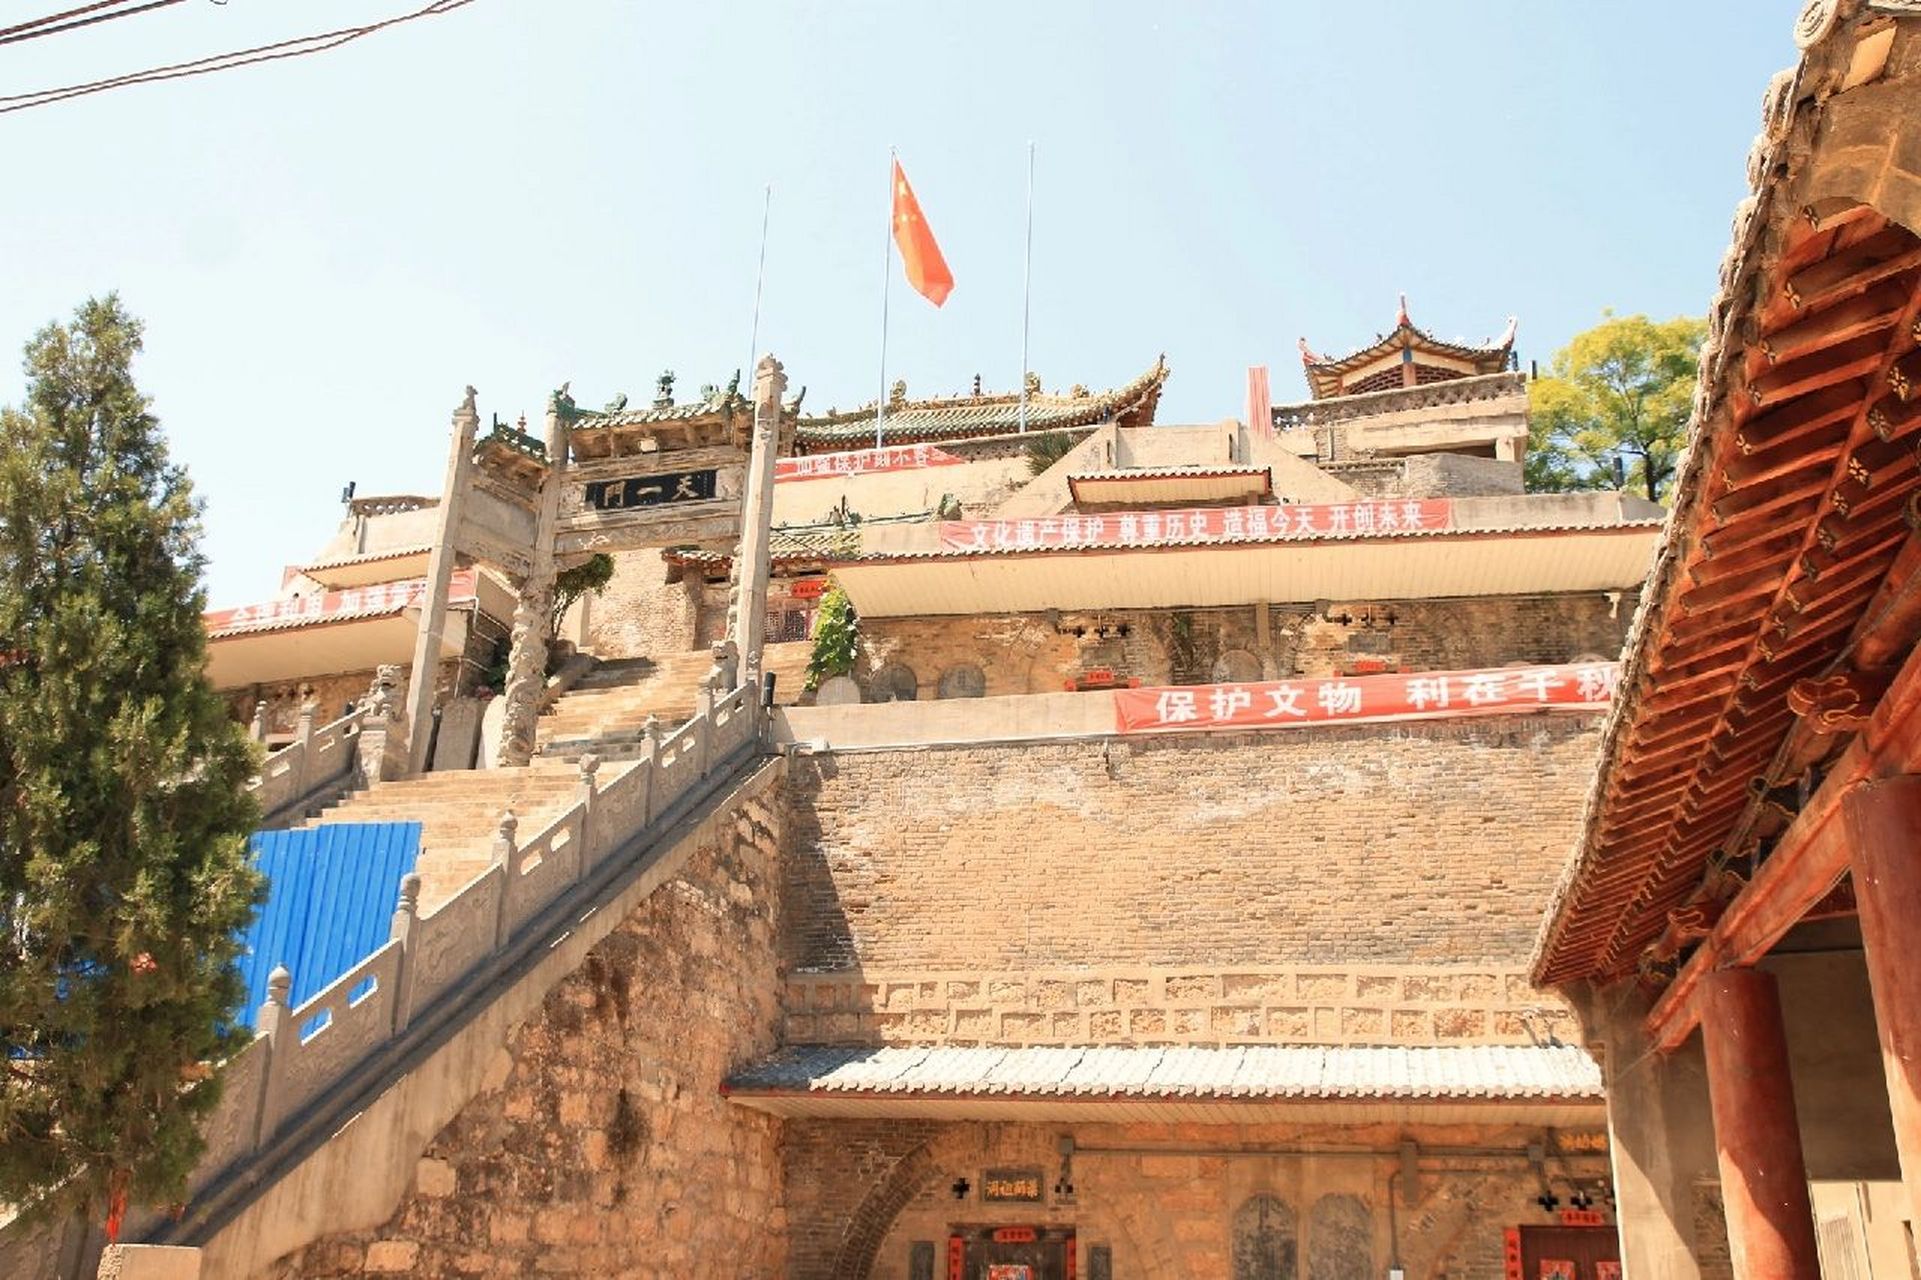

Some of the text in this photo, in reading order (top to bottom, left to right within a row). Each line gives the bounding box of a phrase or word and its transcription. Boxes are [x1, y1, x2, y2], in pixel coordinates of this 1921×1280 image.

[970, 501, 1423, 549] 文化遗产保护 尊重历史 造福今天 开创未来
[1156, 666, 1617, 723] 保护文物 利在千秋
